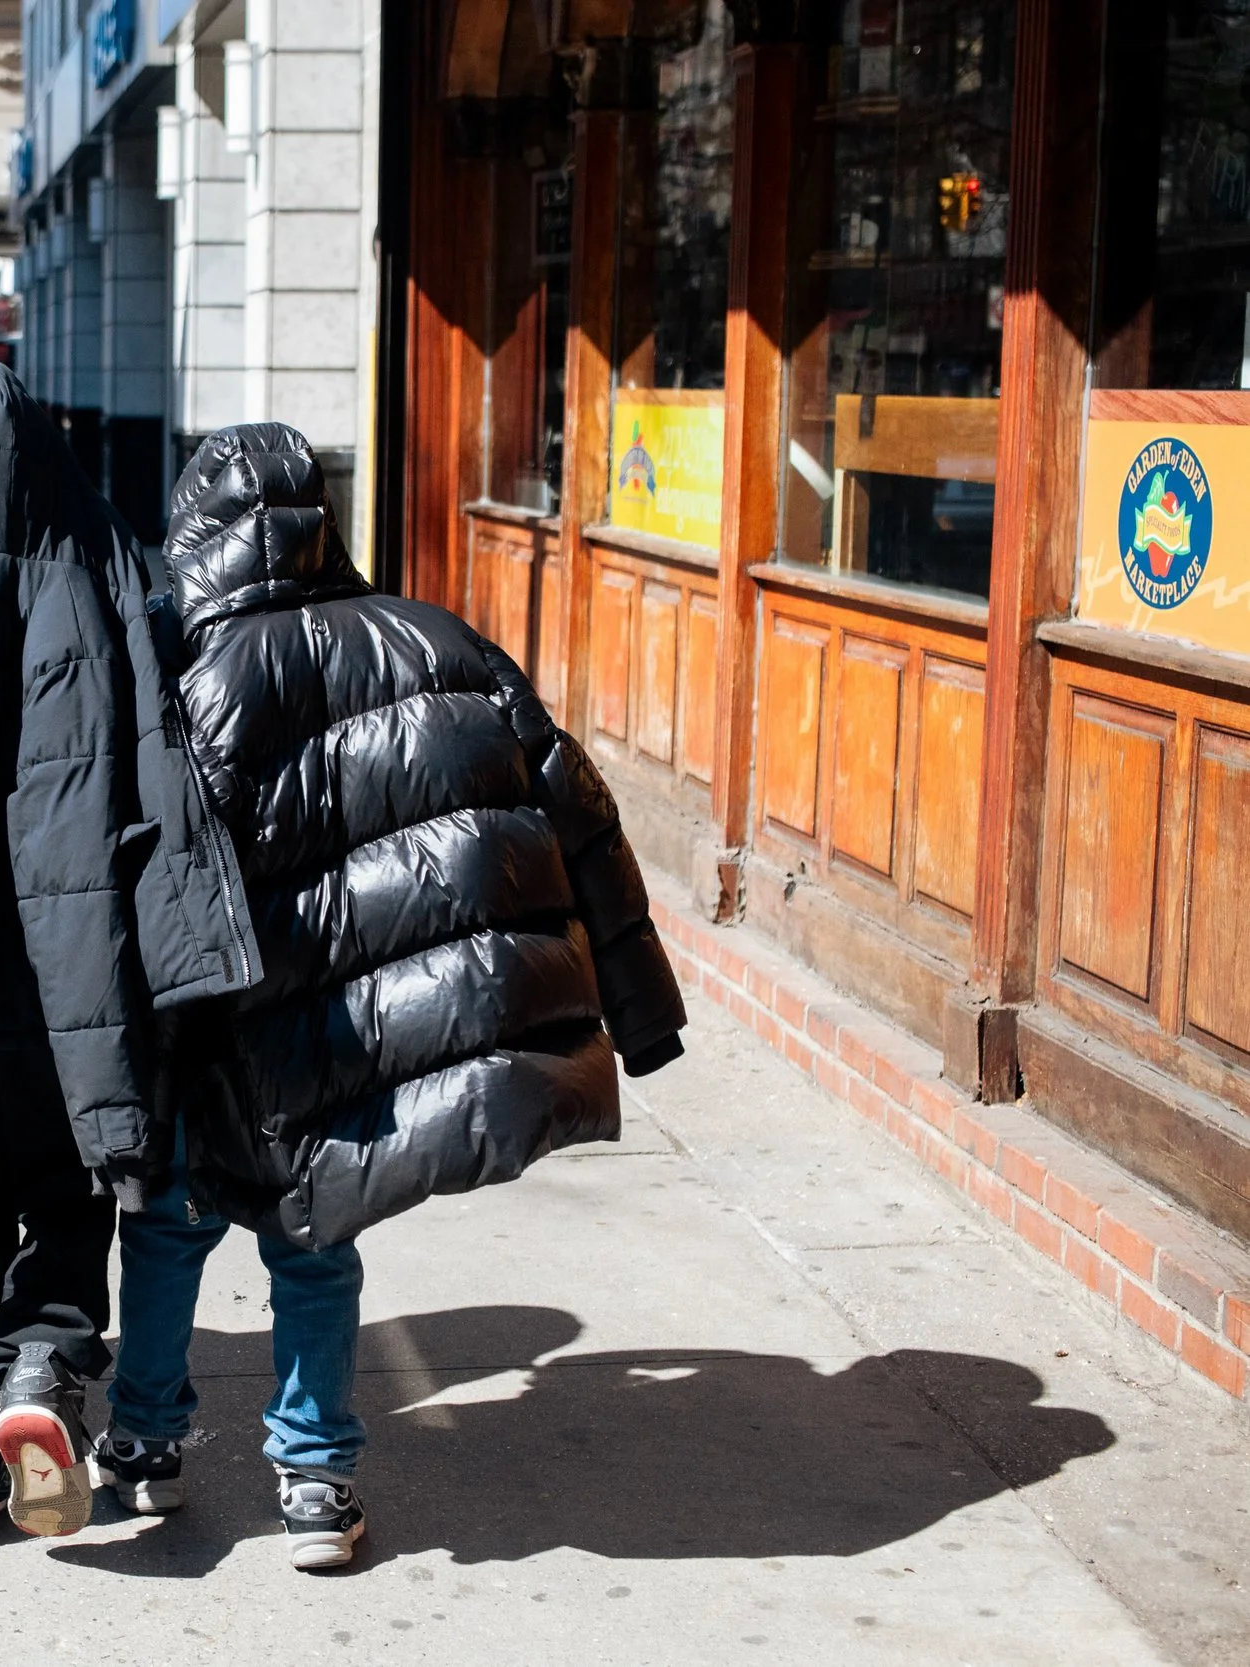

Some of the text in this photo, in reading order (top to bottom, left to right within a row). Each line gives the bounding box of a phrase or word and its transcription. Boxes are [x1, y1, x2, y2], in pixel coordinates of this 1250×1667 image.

[1127, 441, 1207, 503] GARDEN of EDEN
[1123, 546, 1203, 606] MARKETPLACE
[18, 1367, 43, 1377] NIKE
